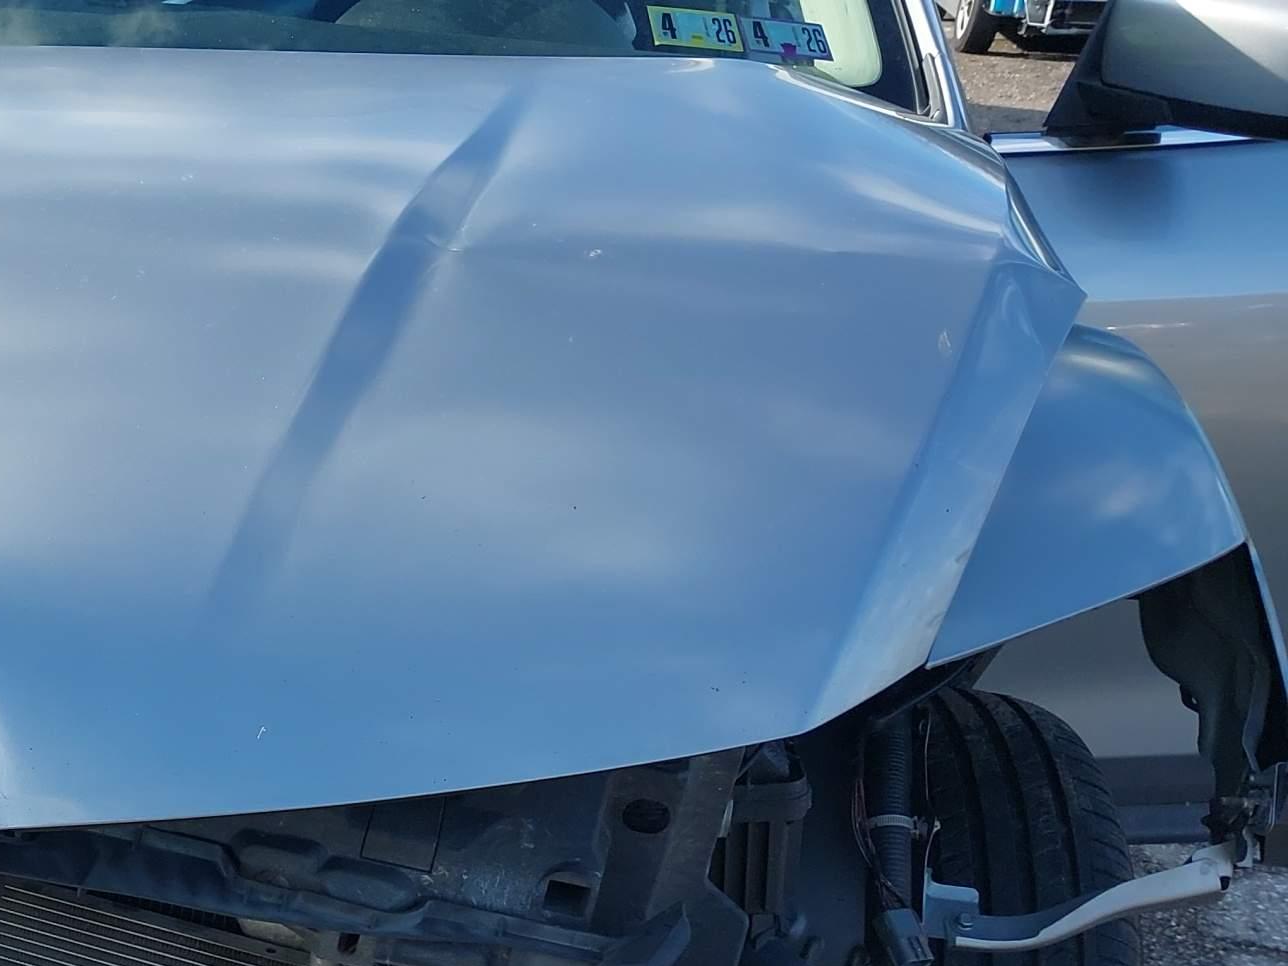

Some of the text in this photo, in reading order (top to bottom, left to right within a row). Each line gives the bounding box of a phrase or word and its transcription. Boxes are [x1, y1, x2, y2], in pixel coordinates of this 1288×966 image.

[661, 12, 737, 44] 4 26
[752, 21, 827, 54] 4 26
